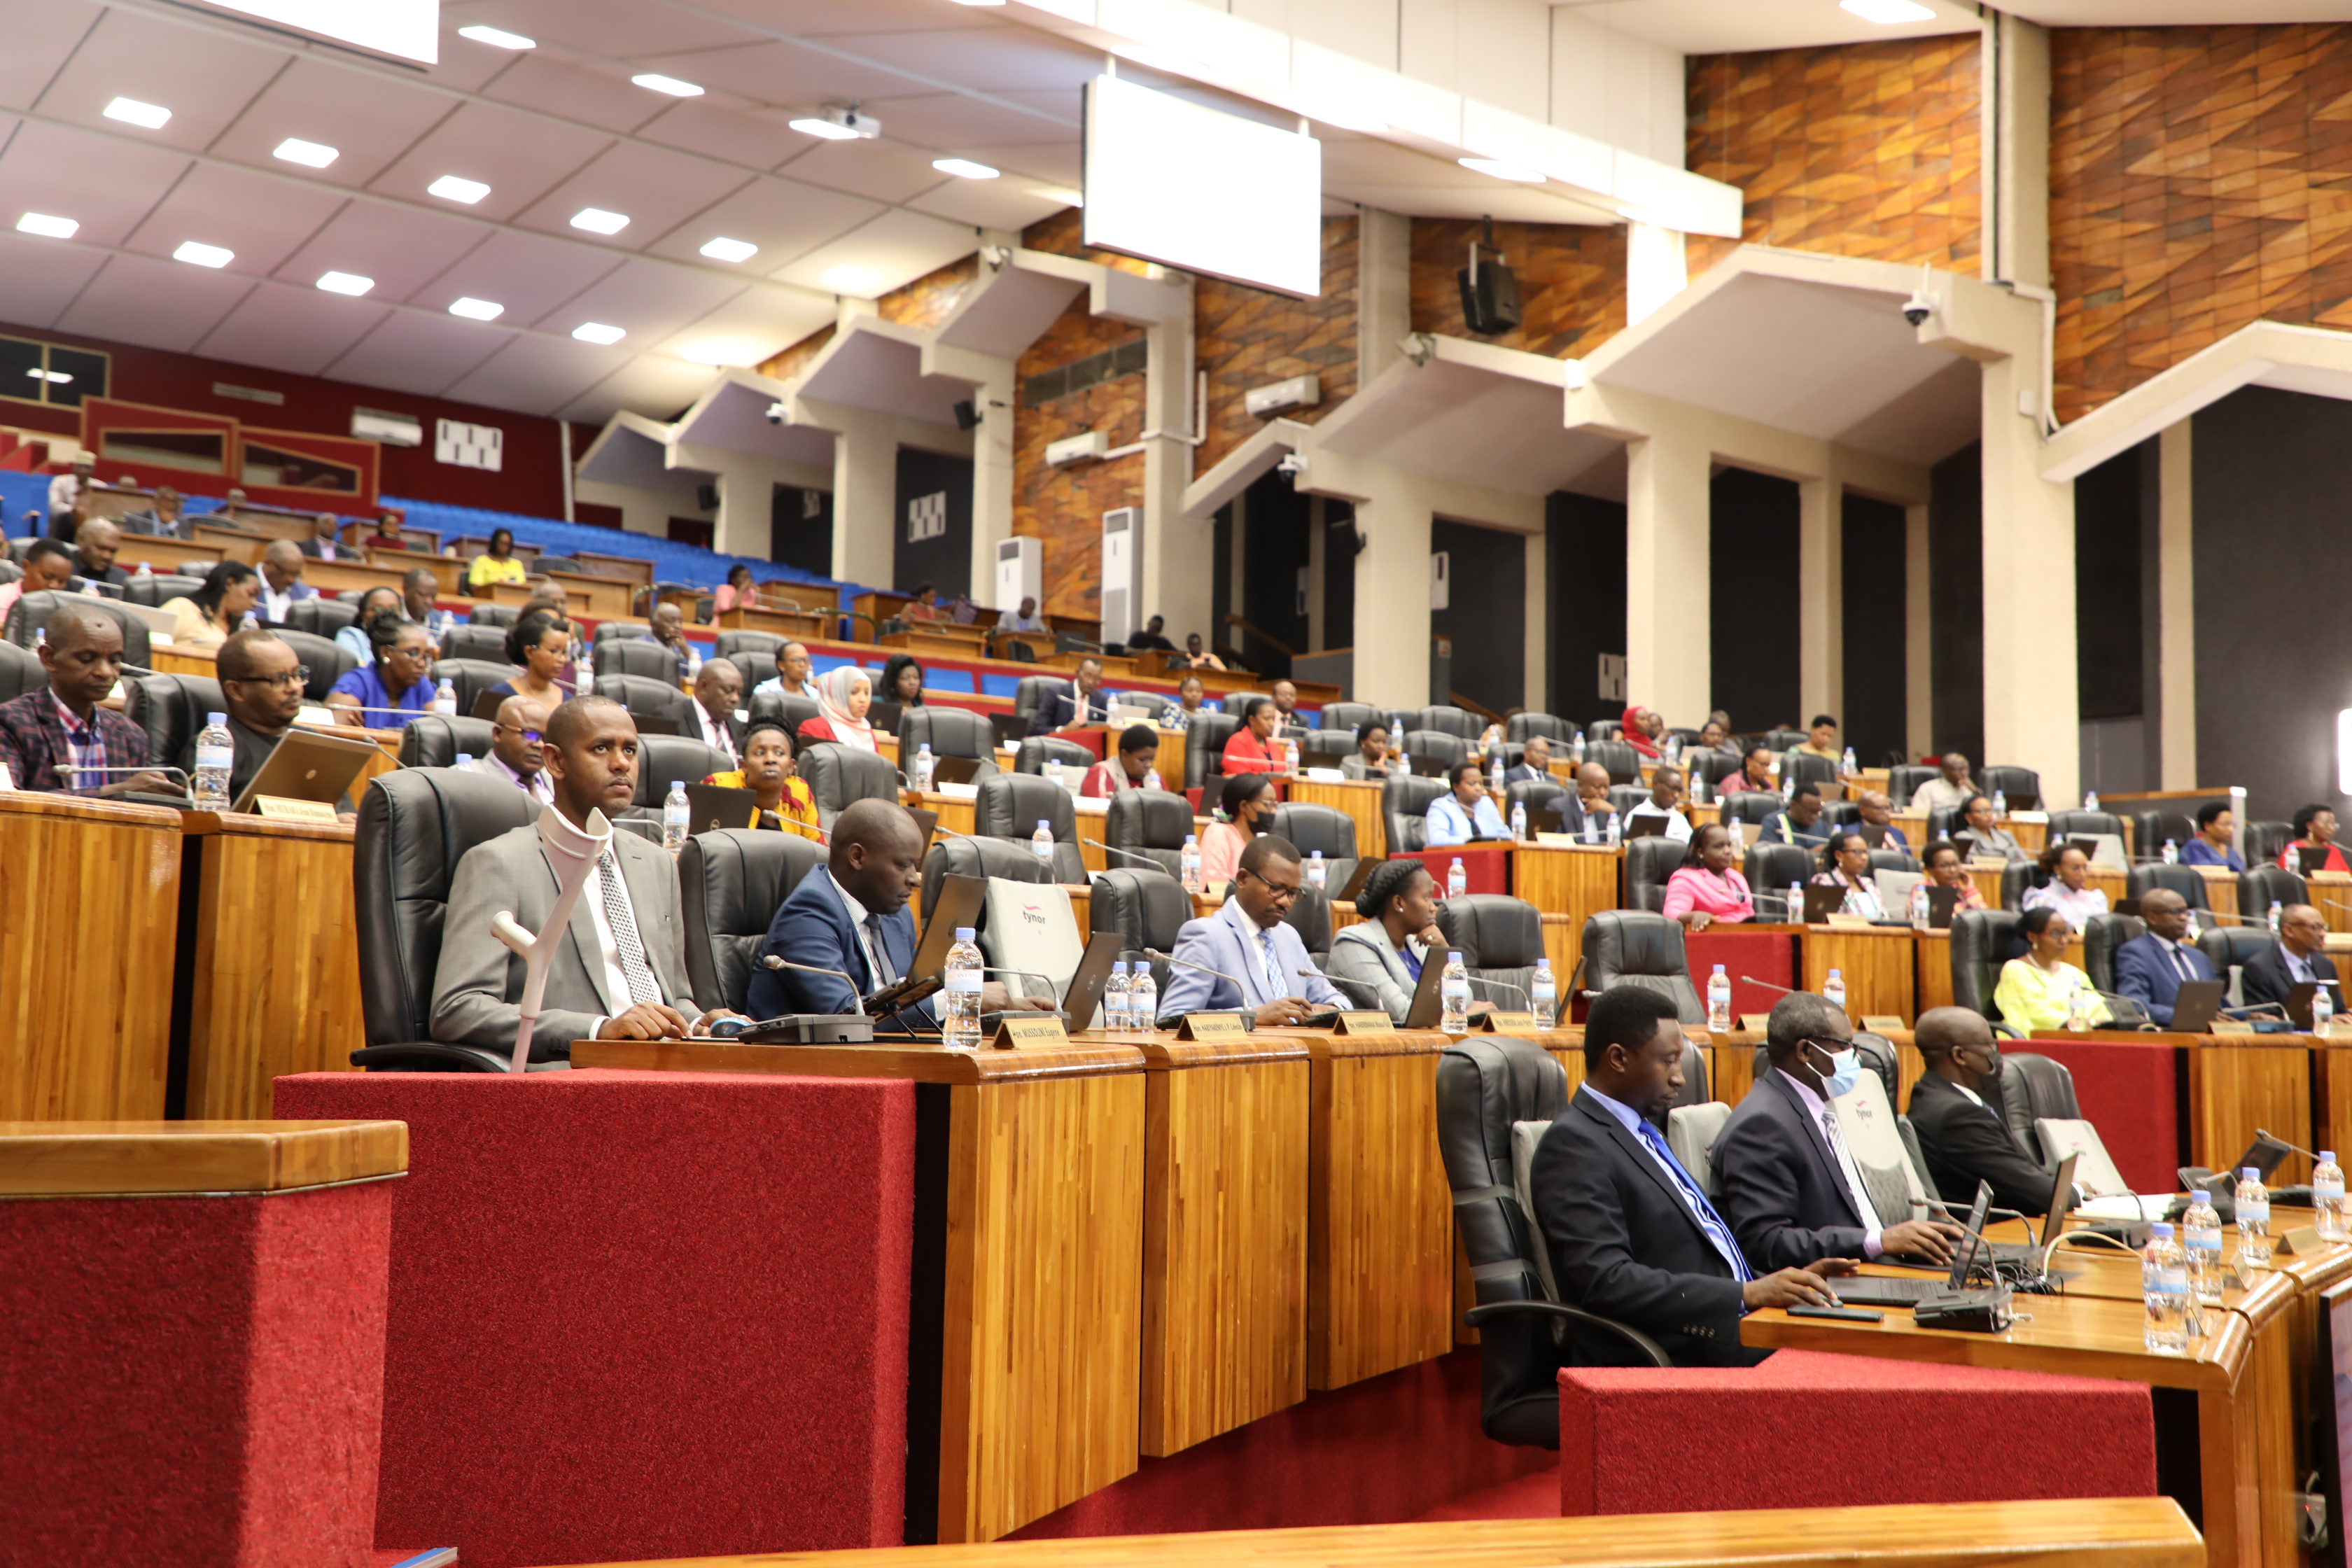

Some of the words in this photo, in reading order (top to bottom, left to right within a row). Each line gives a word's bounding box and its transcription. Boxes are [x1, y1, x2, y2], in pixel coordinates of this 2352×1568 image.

[1023, 910, 1046, 924] tynor
[1011, 1029, 1022, 1038] Hon.
[1022, 1028, 1045, 1037] MUSSOLINI
[1045, 1027, 1060, 1039] Eugene
